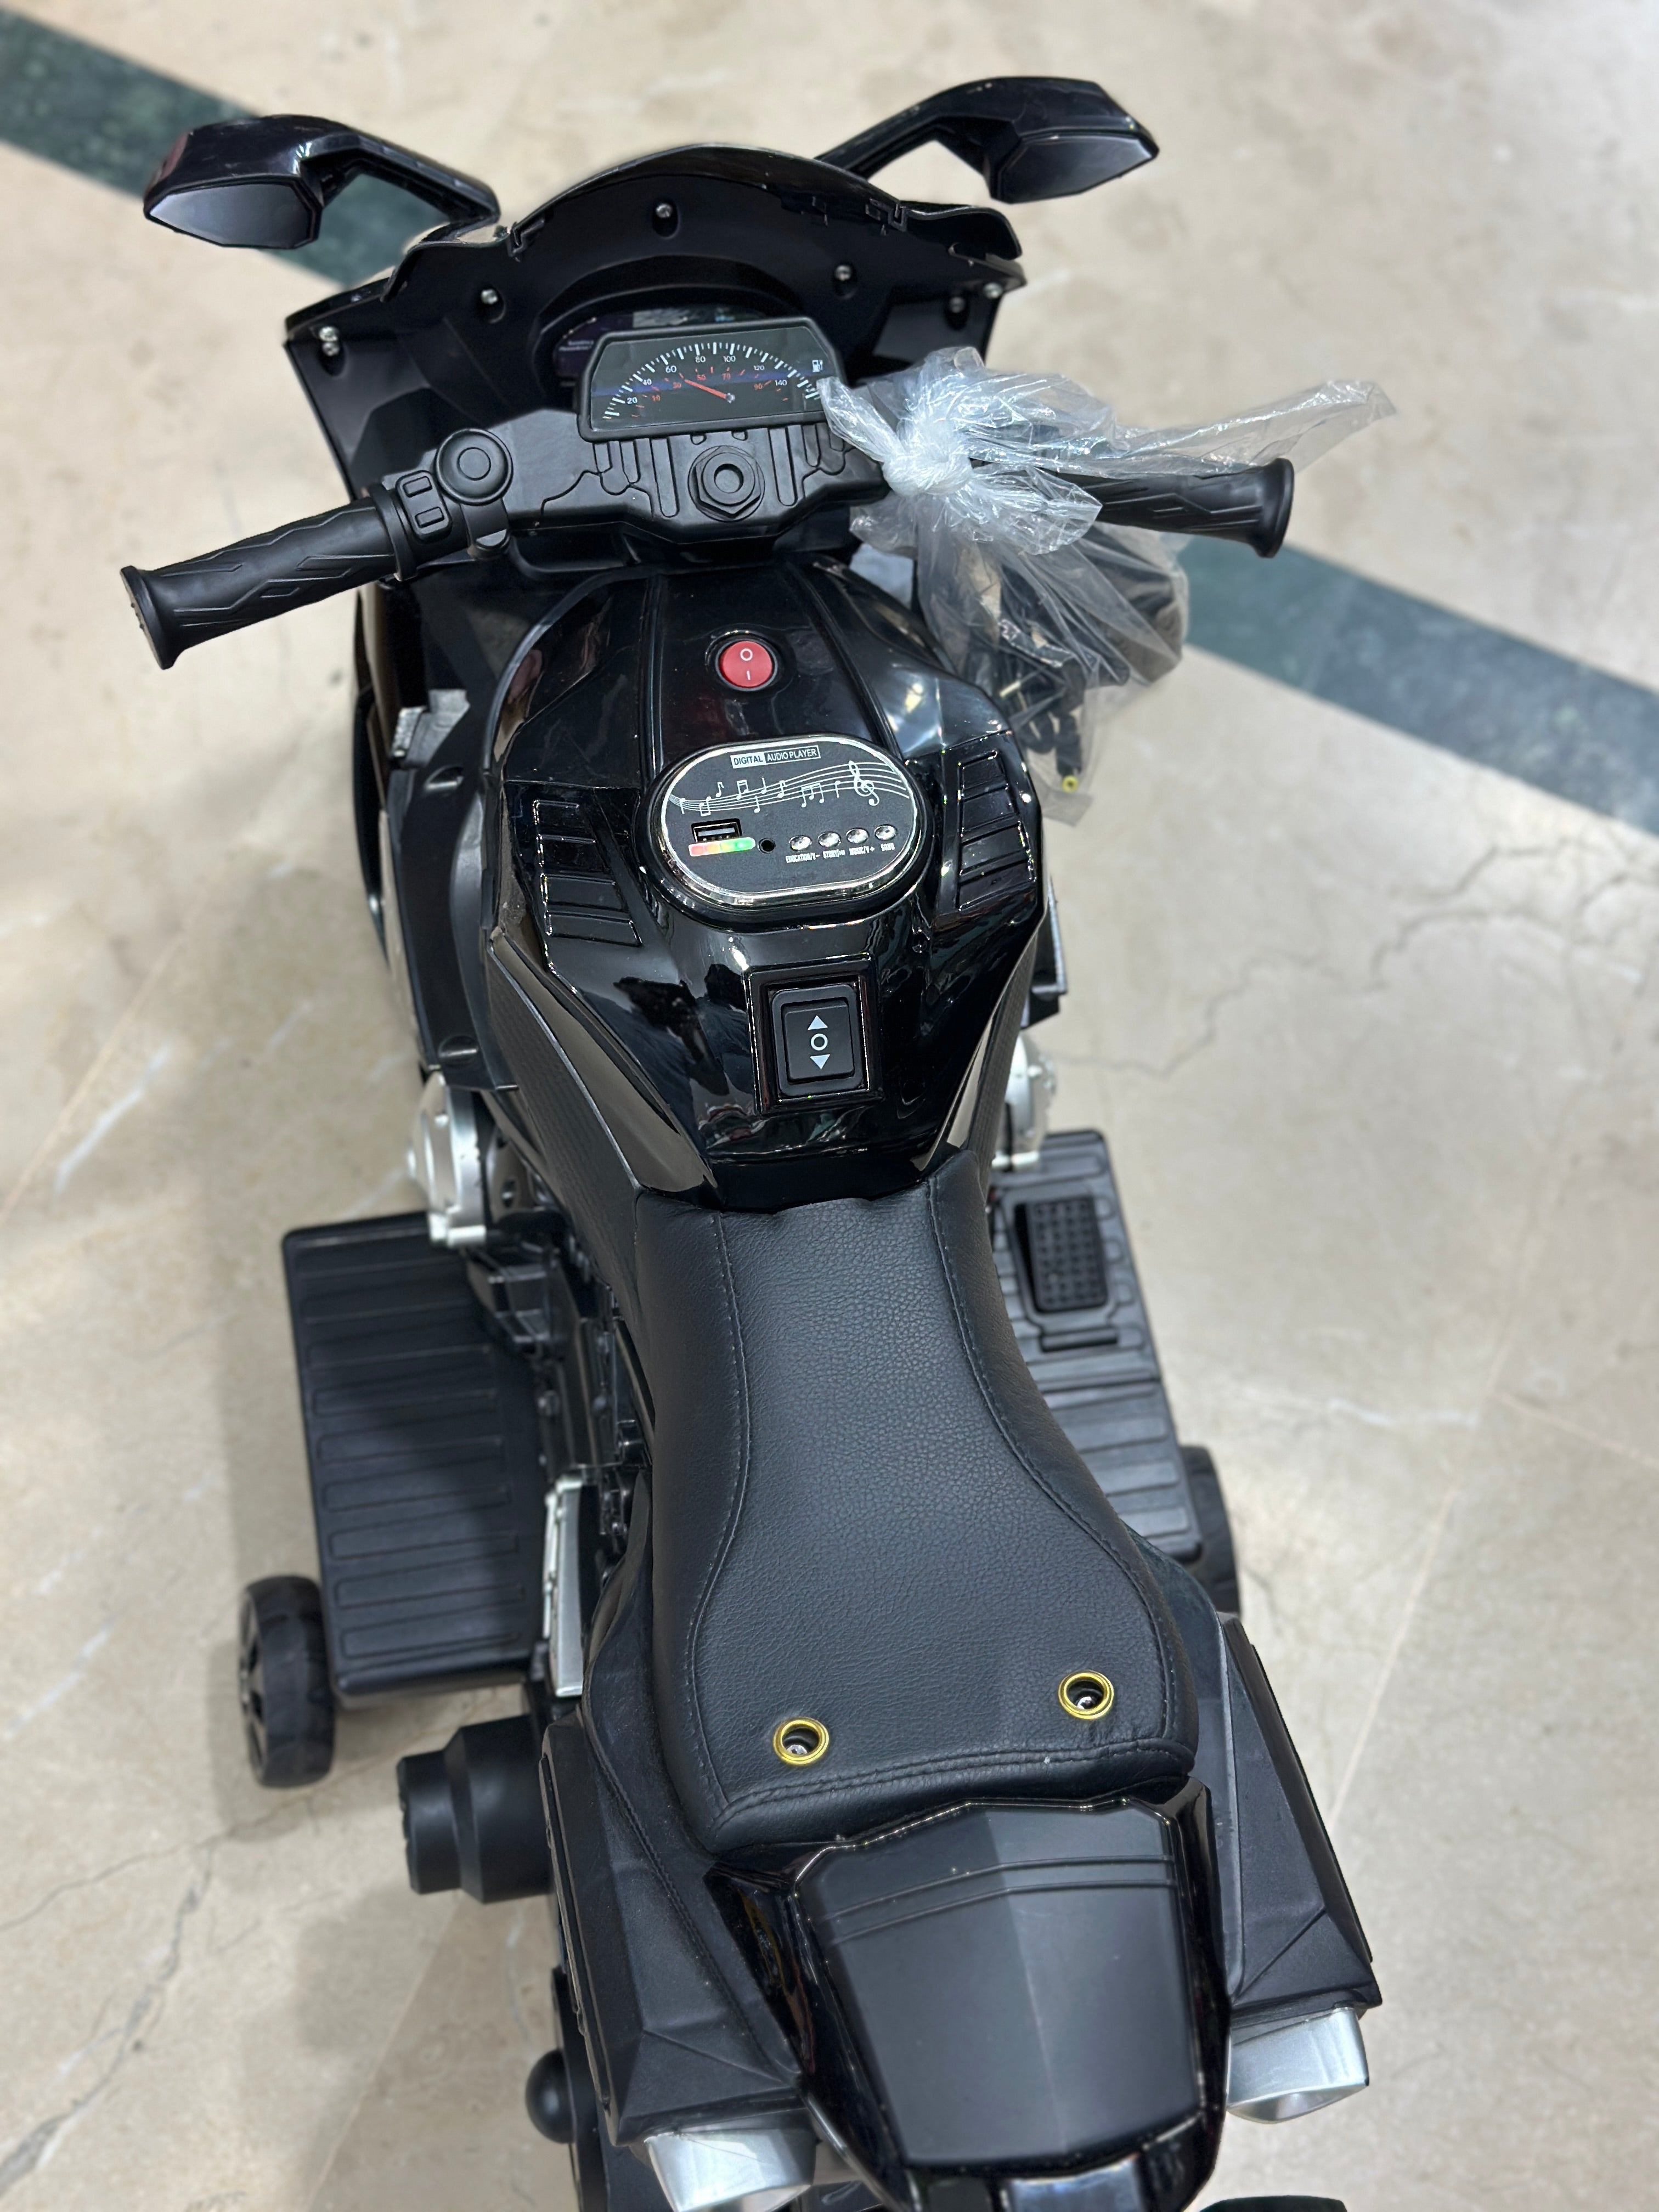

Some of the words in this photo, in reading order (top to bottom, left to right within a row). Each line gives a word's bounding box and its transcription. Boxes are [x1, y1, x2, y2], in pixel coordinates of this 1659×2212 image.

[733, 755, 763, 765] DIGITAL
[767, 752, 789, 762] AUDIO
[789, 748, 817, 759] PLAYER
